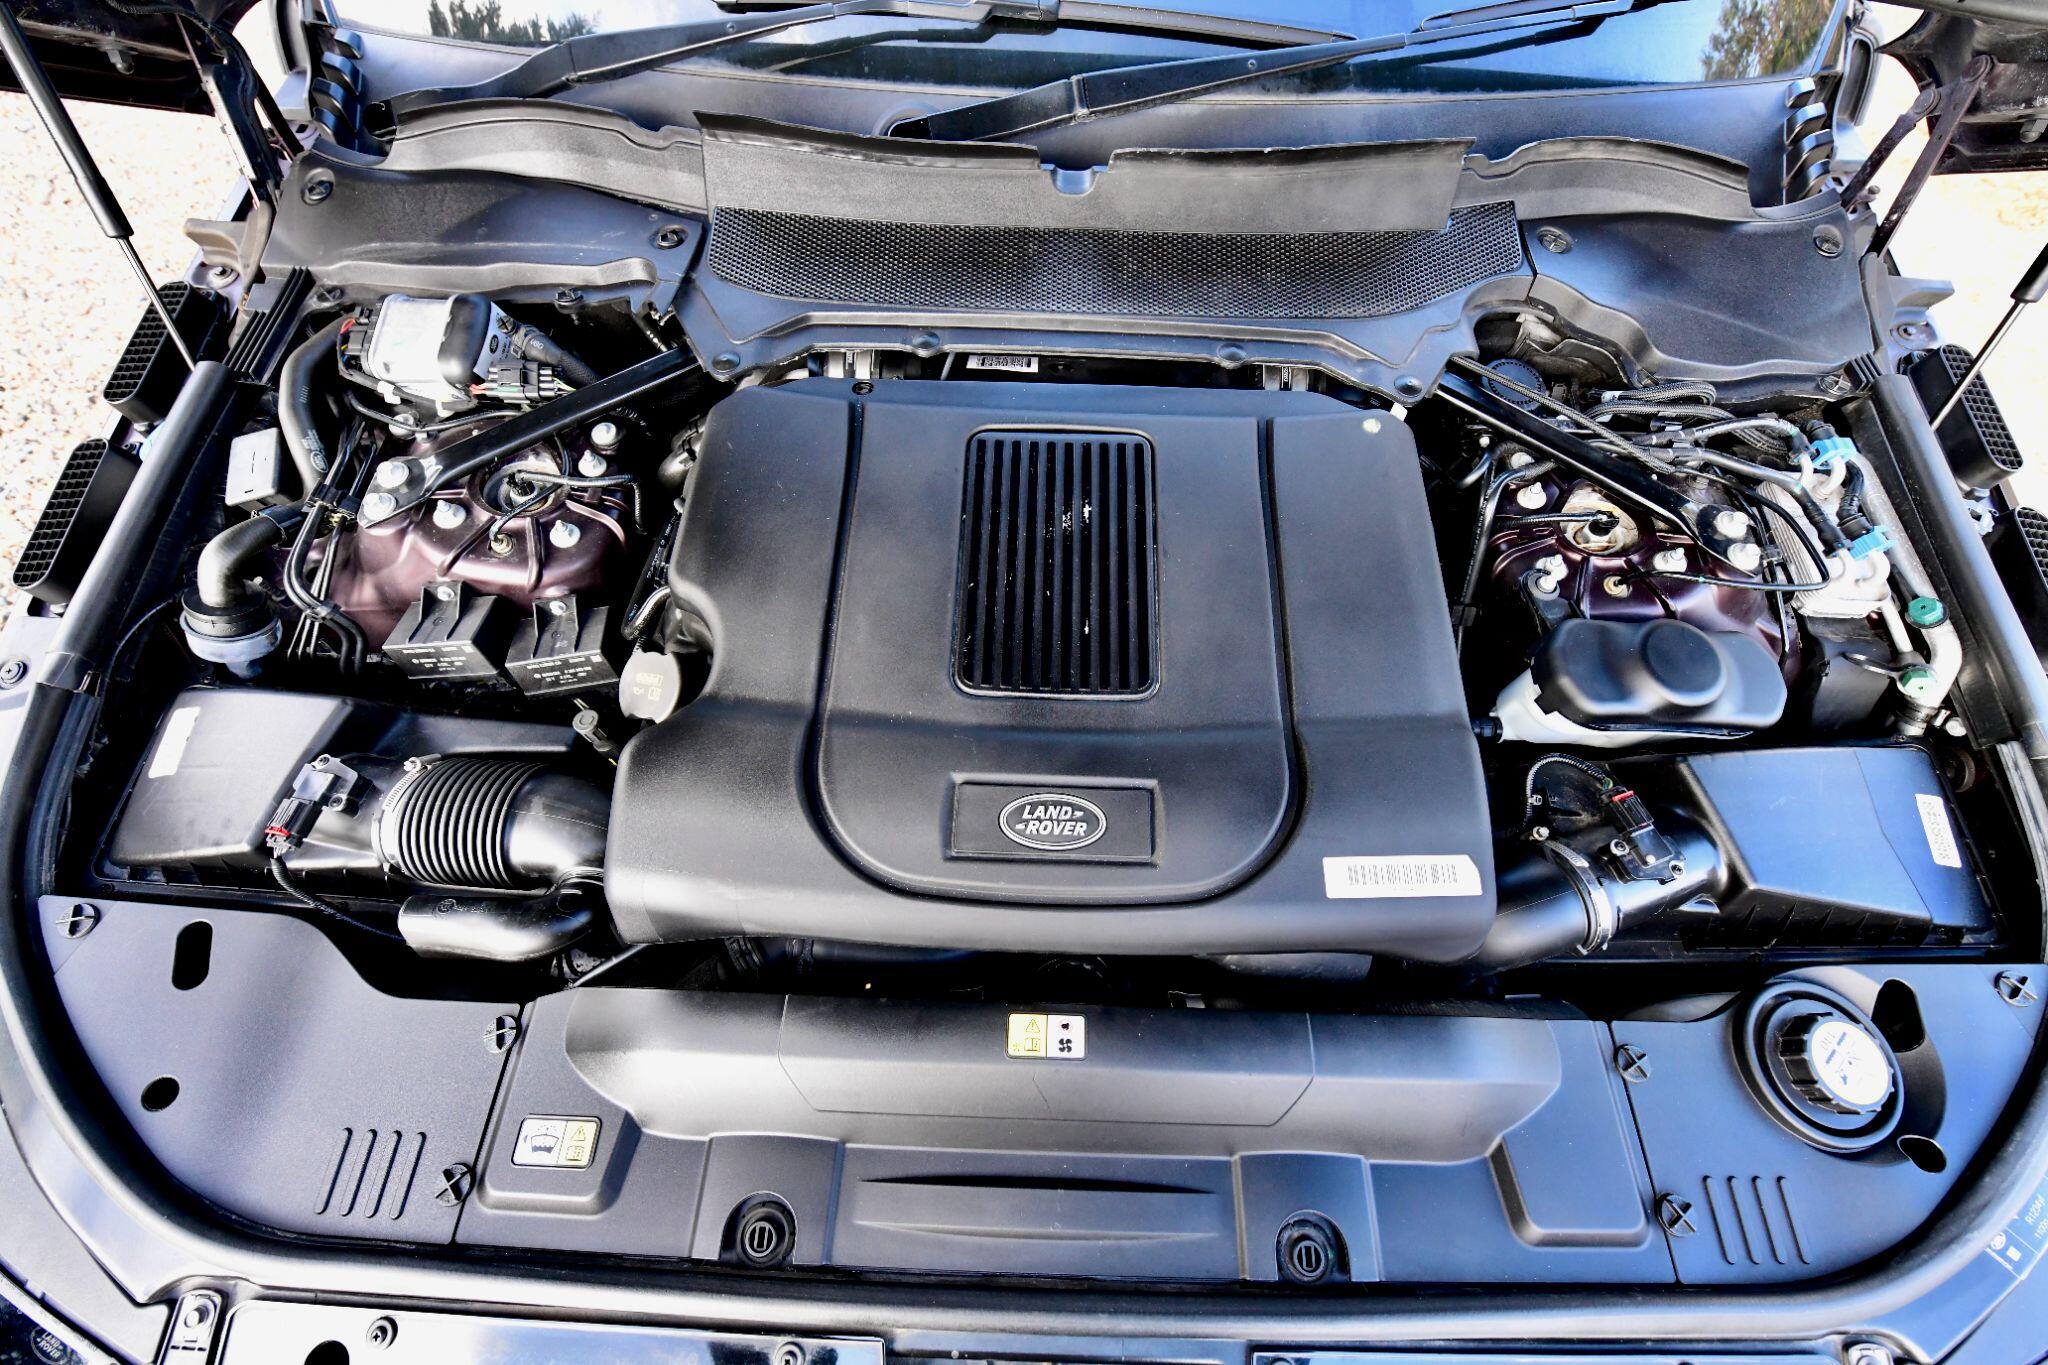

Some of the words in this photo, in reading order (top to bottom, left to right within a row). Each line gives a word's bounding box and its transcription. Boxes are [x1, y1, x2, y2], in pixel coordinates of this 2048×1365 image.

[1022, 804, 1073, 819] LAND
[1026, 820, 1088, 836] ROVER
[42, 1332, 61, 1348] LAND
[39, 1340, 62, 1359] ROVER
